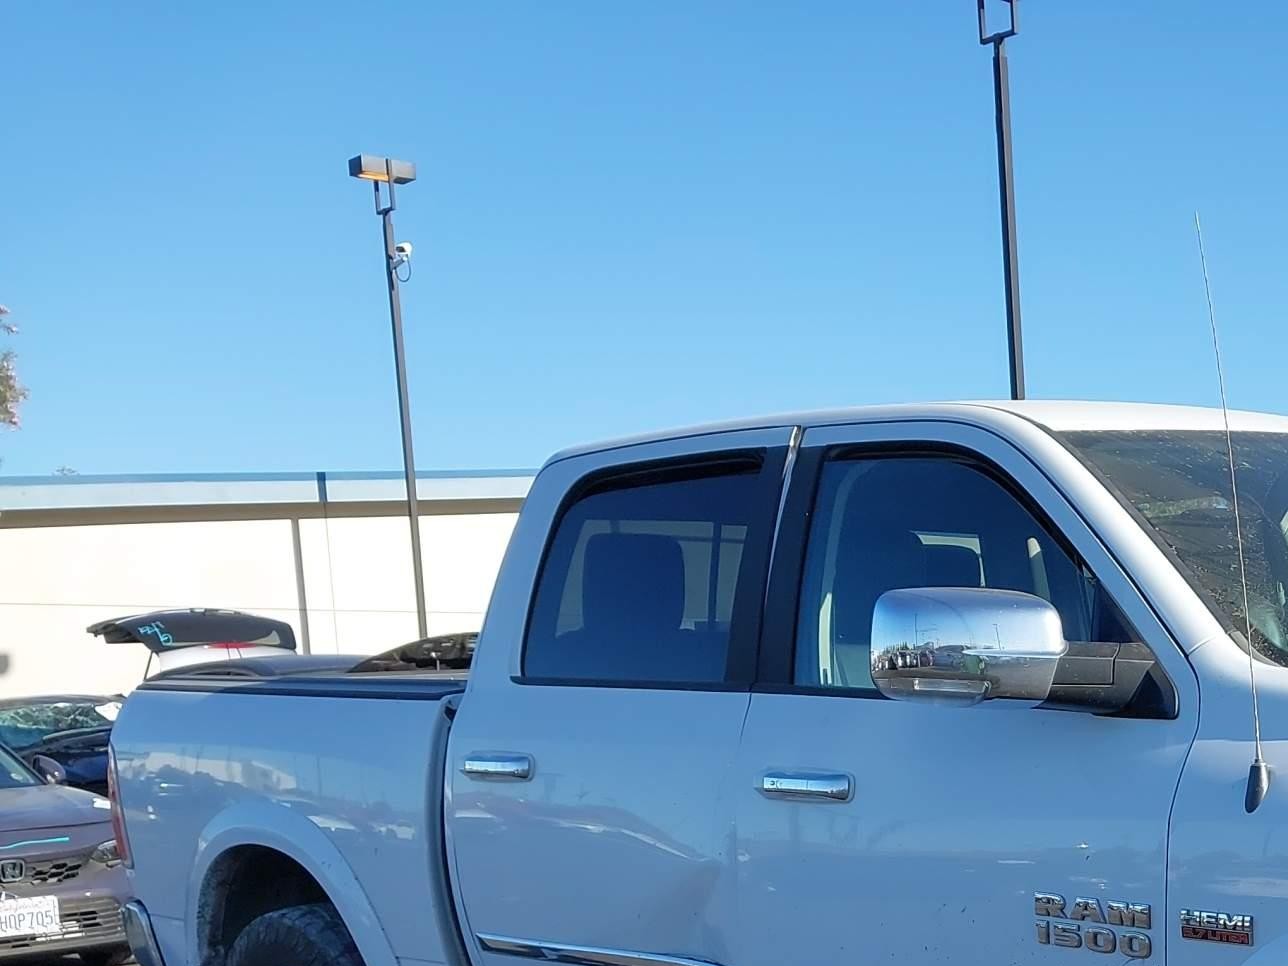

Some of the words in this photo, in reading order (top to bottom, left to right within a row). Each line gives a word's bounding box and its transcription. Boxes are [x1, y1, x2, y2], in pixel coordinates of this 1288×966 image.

[1034, 892, 1152, 930] RAM
[1180, 908, 1253, 931] HEMI
[1036, 920, 1152, 959] 1500
[1207, 930, 1249, 944] LITER
